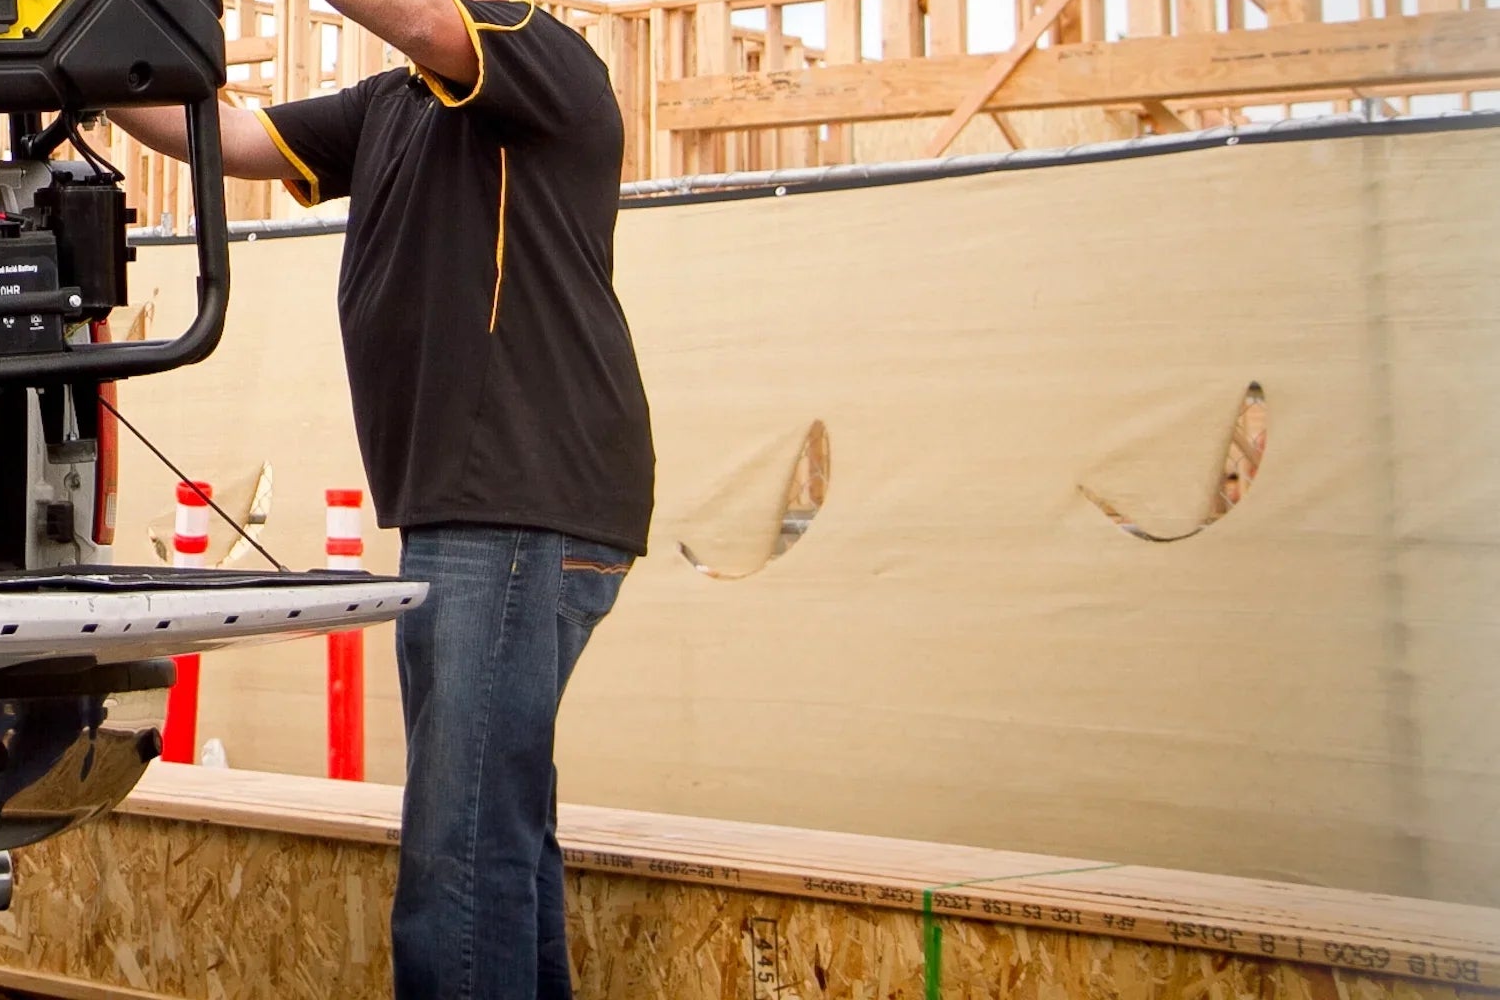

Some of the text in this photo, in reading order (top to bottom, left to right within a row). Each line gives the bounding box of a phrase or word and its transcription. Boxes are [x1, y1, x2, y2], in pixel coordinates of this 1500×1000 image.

[18, 264, 38, 272] Battery
[983, 898, 1012, 916] ESR
[1022, 904, 1042, 920] ES
[1052, 908, 1082, 925] ICC
[1166, 920, 1243, 950] Joist
